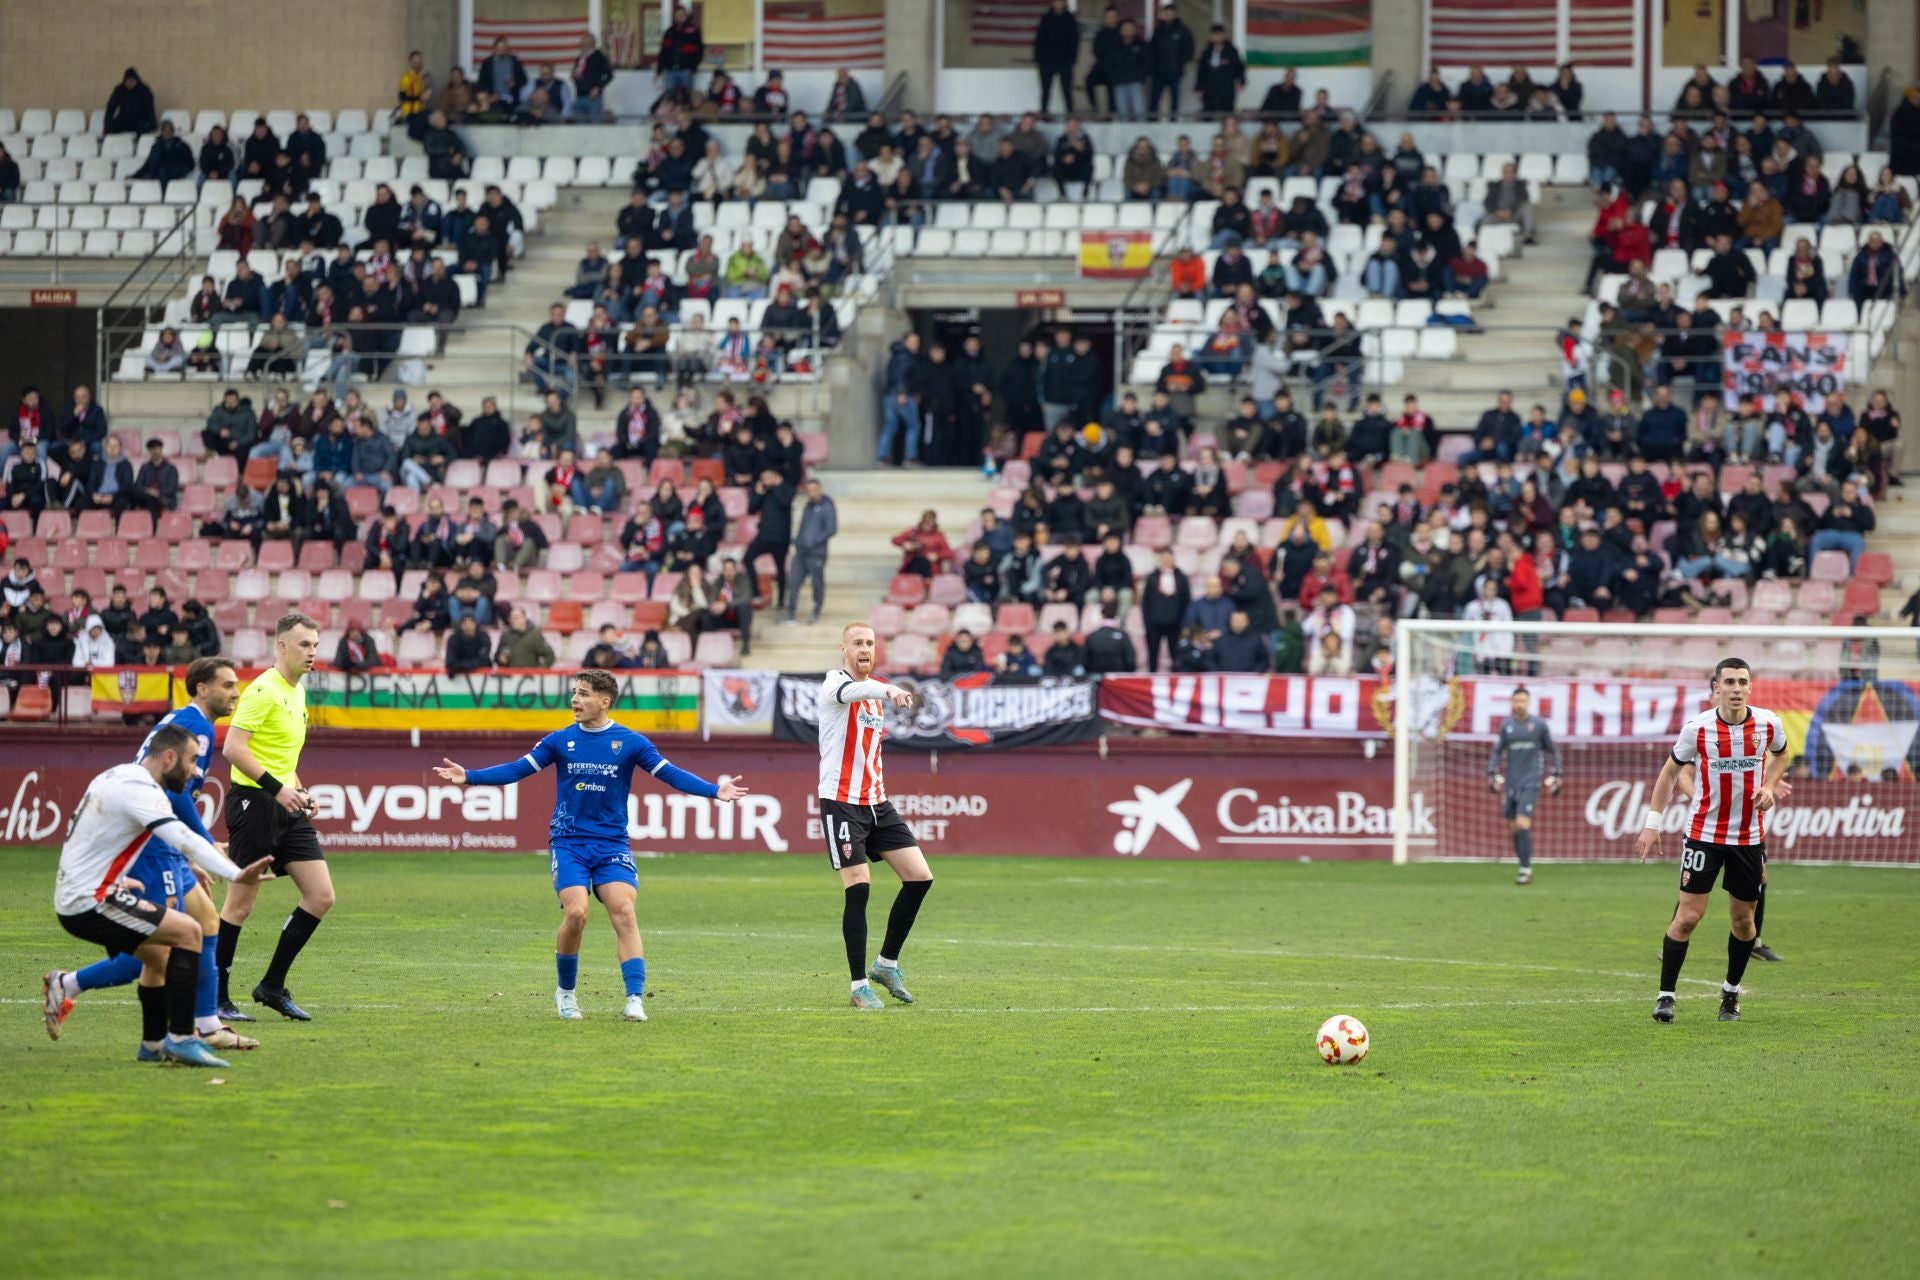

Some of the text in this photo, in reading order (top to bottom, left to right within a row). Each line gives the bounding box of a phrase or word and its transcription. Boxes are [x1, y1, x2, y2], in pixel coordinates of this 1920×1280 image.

[1733, 344, 1837, 364] FANS
[307, 782, 519, 832] ayoral
[838, 821, 850, 841] 4
[1765, 794, 1905, 850] eportiva
[383, 831, 450, 847] Industriales
[452, 836, 461, 849] y
[462, 832, 517, 848] Servicios
[1683, 847, 1705, 871] 30
[163, 871, 176, 895] 5
